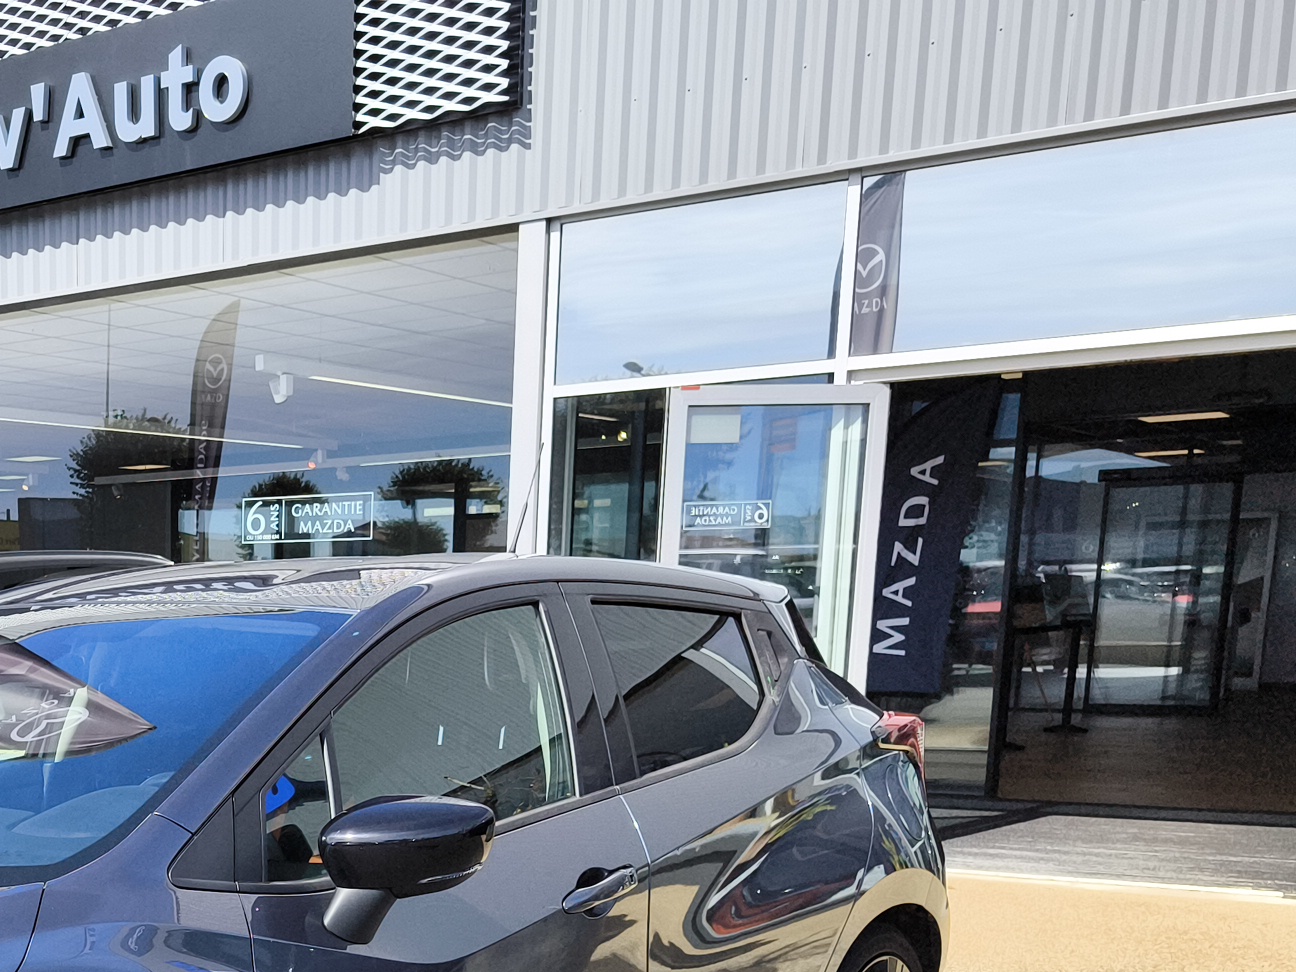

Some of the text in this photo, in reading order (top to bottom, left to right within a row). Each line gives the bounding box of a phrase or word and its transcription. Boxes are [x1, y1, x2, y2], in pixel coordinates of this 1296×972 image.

[246, 500, 280, 535] 6 ANS
[291, 500, 364, 517] GARANTIE
[298, 518, 355, 534] MAZDA
[872, 454, 946, 657] MAZDA
